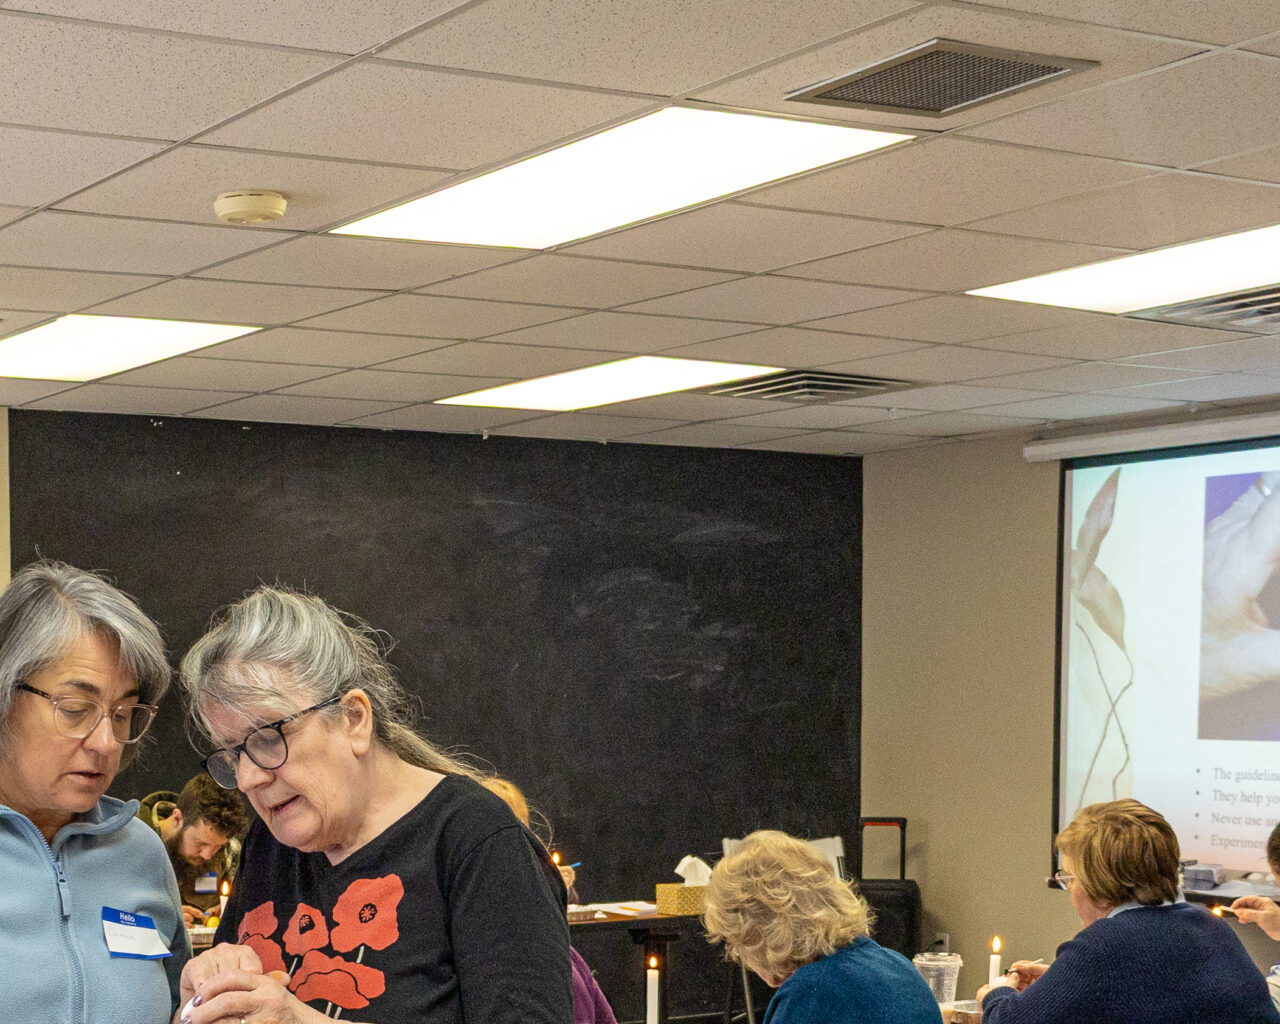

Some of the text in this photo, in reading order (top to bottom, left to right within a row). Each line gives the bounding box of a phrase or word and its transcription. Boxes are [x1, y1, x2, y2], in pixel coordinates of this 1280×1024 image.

[1212, 767, 1232, 780] The
[1212, 789, 1280, 806] They help yo
[1211, 811, 1243, 825] Never
[1245, 816, 1262, 826] use
[1211, 834, 1266, 850] Experimen
